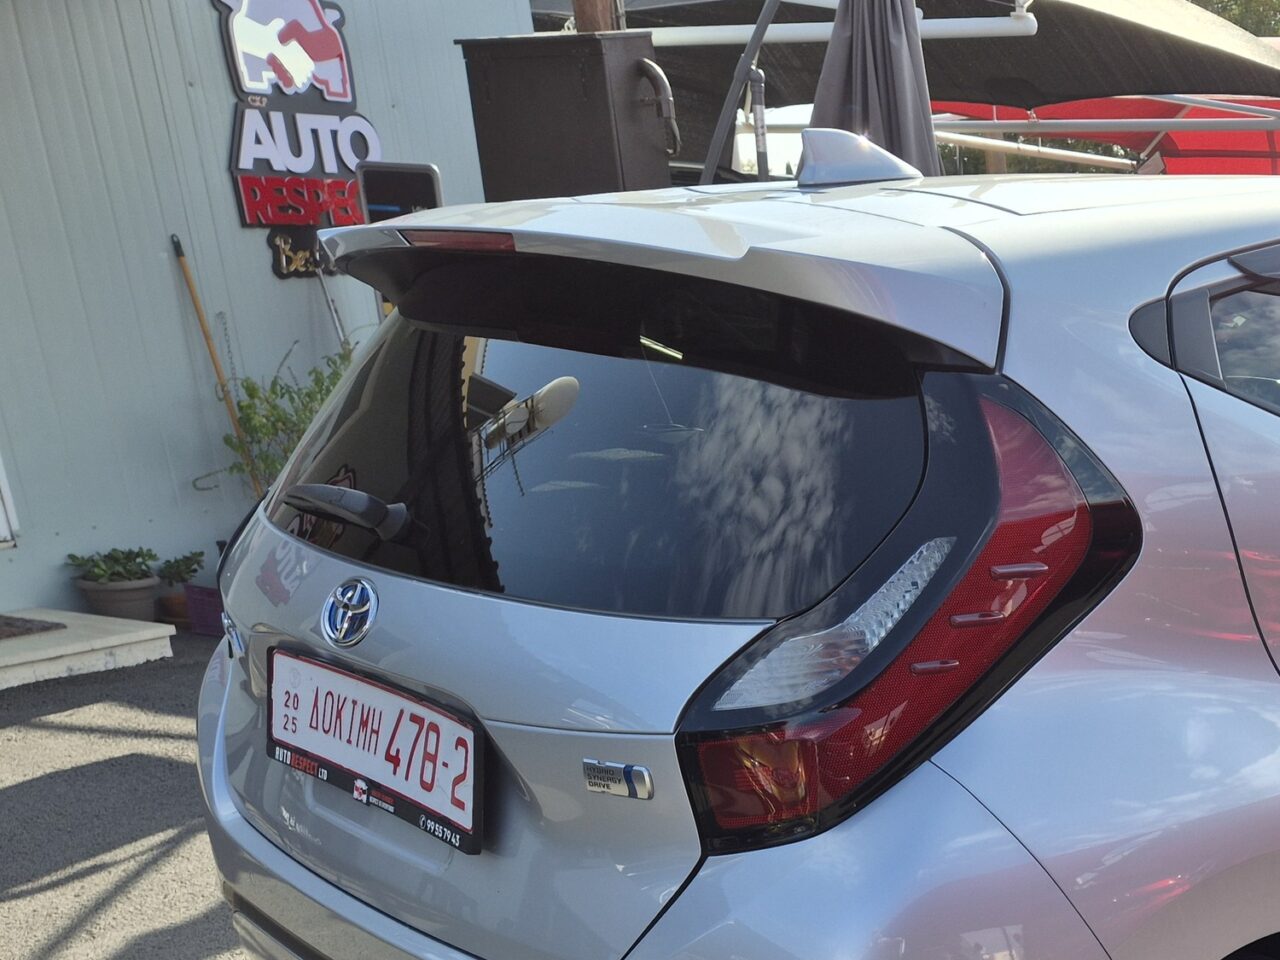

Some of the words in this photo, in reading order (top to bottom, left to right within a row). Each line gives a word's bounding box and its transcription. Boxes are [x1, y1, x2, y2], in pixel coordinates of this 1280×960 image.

[238, 108, 382, 174] AUTO
[238, 176, 366, 226] RESPEC
[284, 690, 299, 710] 20
[283, 713, 298, 734] 25
[385, 708, 469, 812] 478-2
[587, 774, 622, 785] SYNERGY
[588, 780, 612, 790] DRIVE
